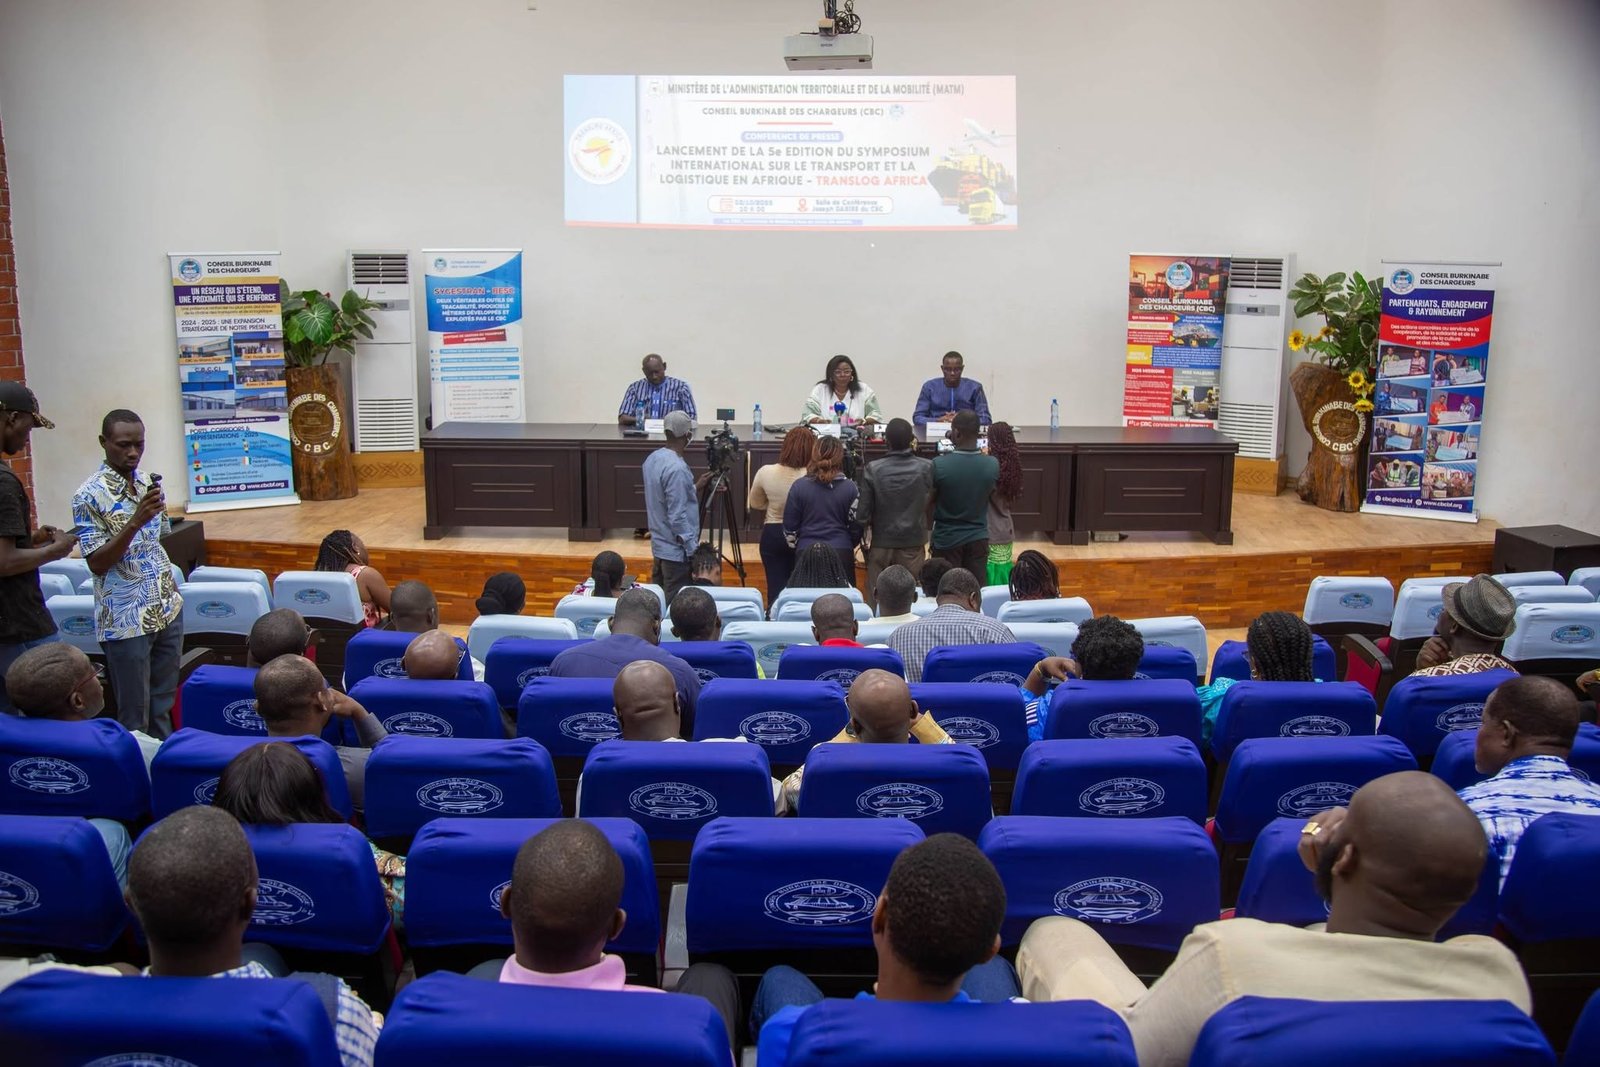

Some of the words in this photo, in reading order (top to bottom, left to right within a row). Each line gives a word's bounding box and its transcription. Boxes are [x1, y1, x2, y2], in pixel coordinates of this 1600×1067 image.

[667, 82, 709, 95] MINISTÈRE
[710, 84, 721, 95] DE
[722, 84, 798, 95] L'ADMINISTRATION
[800, 84, 855, 95] TERRITORIALE
[857, 85, 866, 95] ET
[868, 85, 878, 95] DE
[880, 85, 891, 95] LA
[893, 83, 931, 95] MOBILITÉ
[932, 84, 965, 96] (MATM)
[702, 107, 738, 116] CONSEIL
[789, 108, 805, 116] DES
[807, 108, 858, 116] CHARGEURS
[860, 107, 884, 117] (CBC)
[799, 132, 809, 141] DE
[811, 132, 841, 141] PRESSE
[656, 145, 728, 157] LANCEMENT
[731, 146, 746, 157] DE
[749, 146, 765, 157] LA
[768, 147, 782, 157] 5e
[785, 146, 834, 157] EDITION
[837, 147, 854, 157] DU
[856, 146, 930, 157] SYMPOSIUM
[671, 159, 765, 171] INTERNATIONAL
[768, 161, 791, 171] SUR
[794, 161, 807, 171] LE
[810, 161, 880, 172] TRANSPORT
[884, 161, 896, 172] ET
[900, 161, 916, 172] LA
[659, 174, 729, 185] LOGISTIQUE
[732, 175, 748, 185] EN
[751, 175, 803, 186] AFRIQUE
[816, 176, 880, 186] TRANSLOG
[883, 176, 928, 186] AFRICA
[191, 287, 200, 295] UN
[201, 286, 225, 295] RÉSEAU
[225, 286, 236, 295] QUI
[225, 294, 237, 303] QUI
[237, 294, 246, 302] SE
[246, 293, 277, 302] RENFORCE
[1388, 299, 1440, 308] PARTENARIATS,
[1441, 301, 1488, 310] ENGAGEMENT
[1415, 308, 1467, 317] RAYONNEMENT
[313, 393, 326, 402] DES
[1332, 442, 1353, 452] CBC
